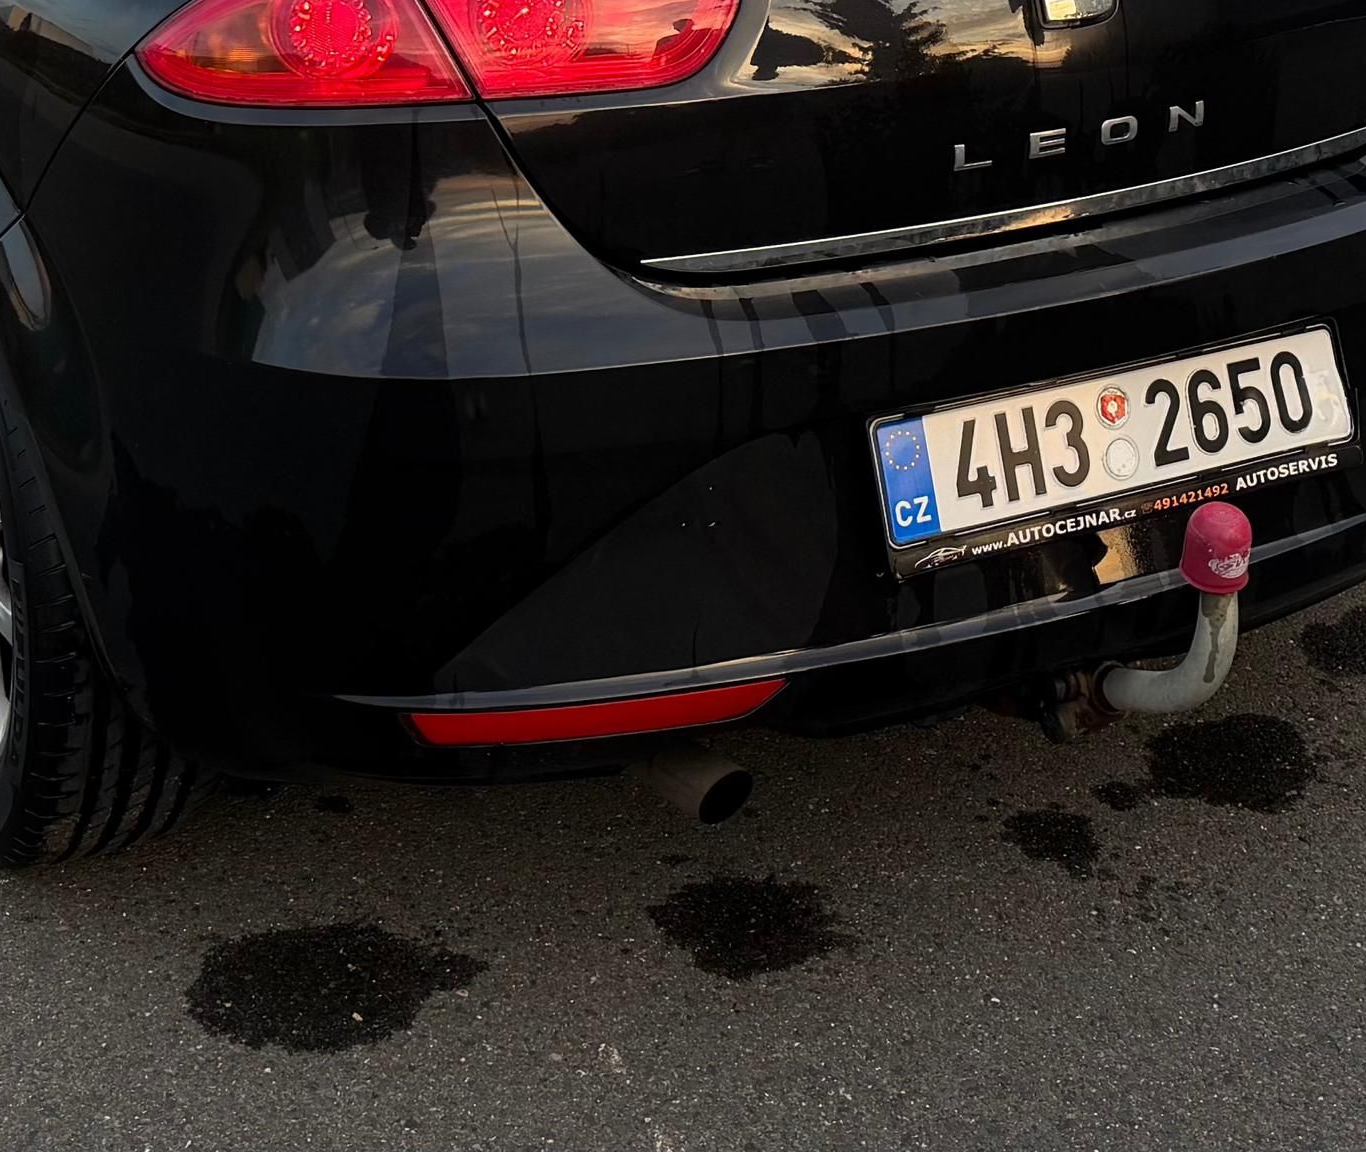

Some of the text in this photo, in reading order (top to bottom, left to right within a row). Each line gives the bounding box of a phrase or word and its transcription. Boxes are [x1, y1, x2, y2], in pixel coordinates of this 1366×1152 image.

[953, 100, 1205, 171] LEON
[955, 350, 1313, 509] 4H3 2650
[894, 495, 932, 528] CZ
[972, 453, 1338, 556] www.AUTOCEJNAR.cz 491421492 AUTOSERVIS
